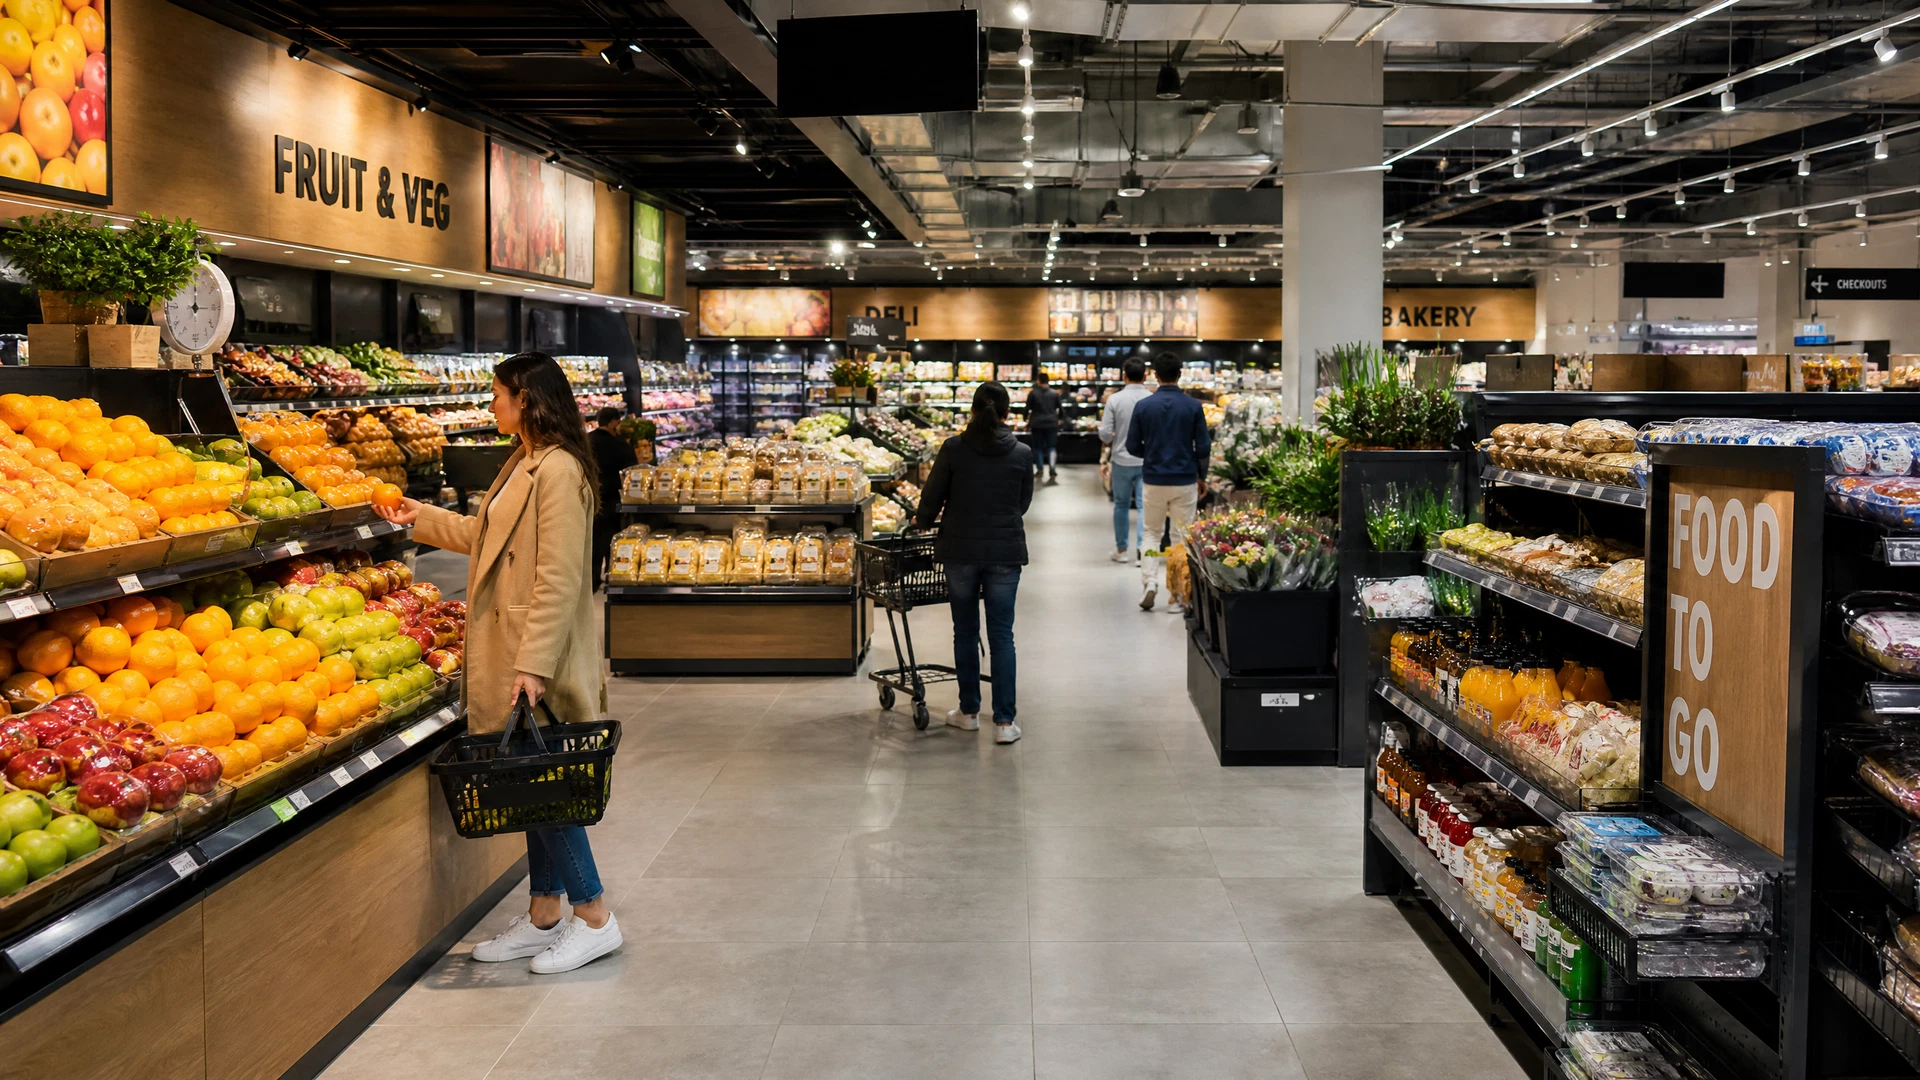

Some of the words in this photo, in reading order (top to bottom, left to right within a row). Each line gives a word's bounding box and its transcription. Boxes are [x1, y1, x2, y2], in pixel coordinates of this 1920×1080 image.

[275, 134, 367, 212] FRUIT
[377, 166, 396, 219] &
[402, 172, 450, 231] VEG
[1382, 306, 1477, 327] BAKERY
[1837, 279, 1887, 289] CHECKOUTS
[1672, 493, 1780, 590] FOOD
[1671, 593, 1713, 681] TO
[1668, 696, 1719, 791] GO
